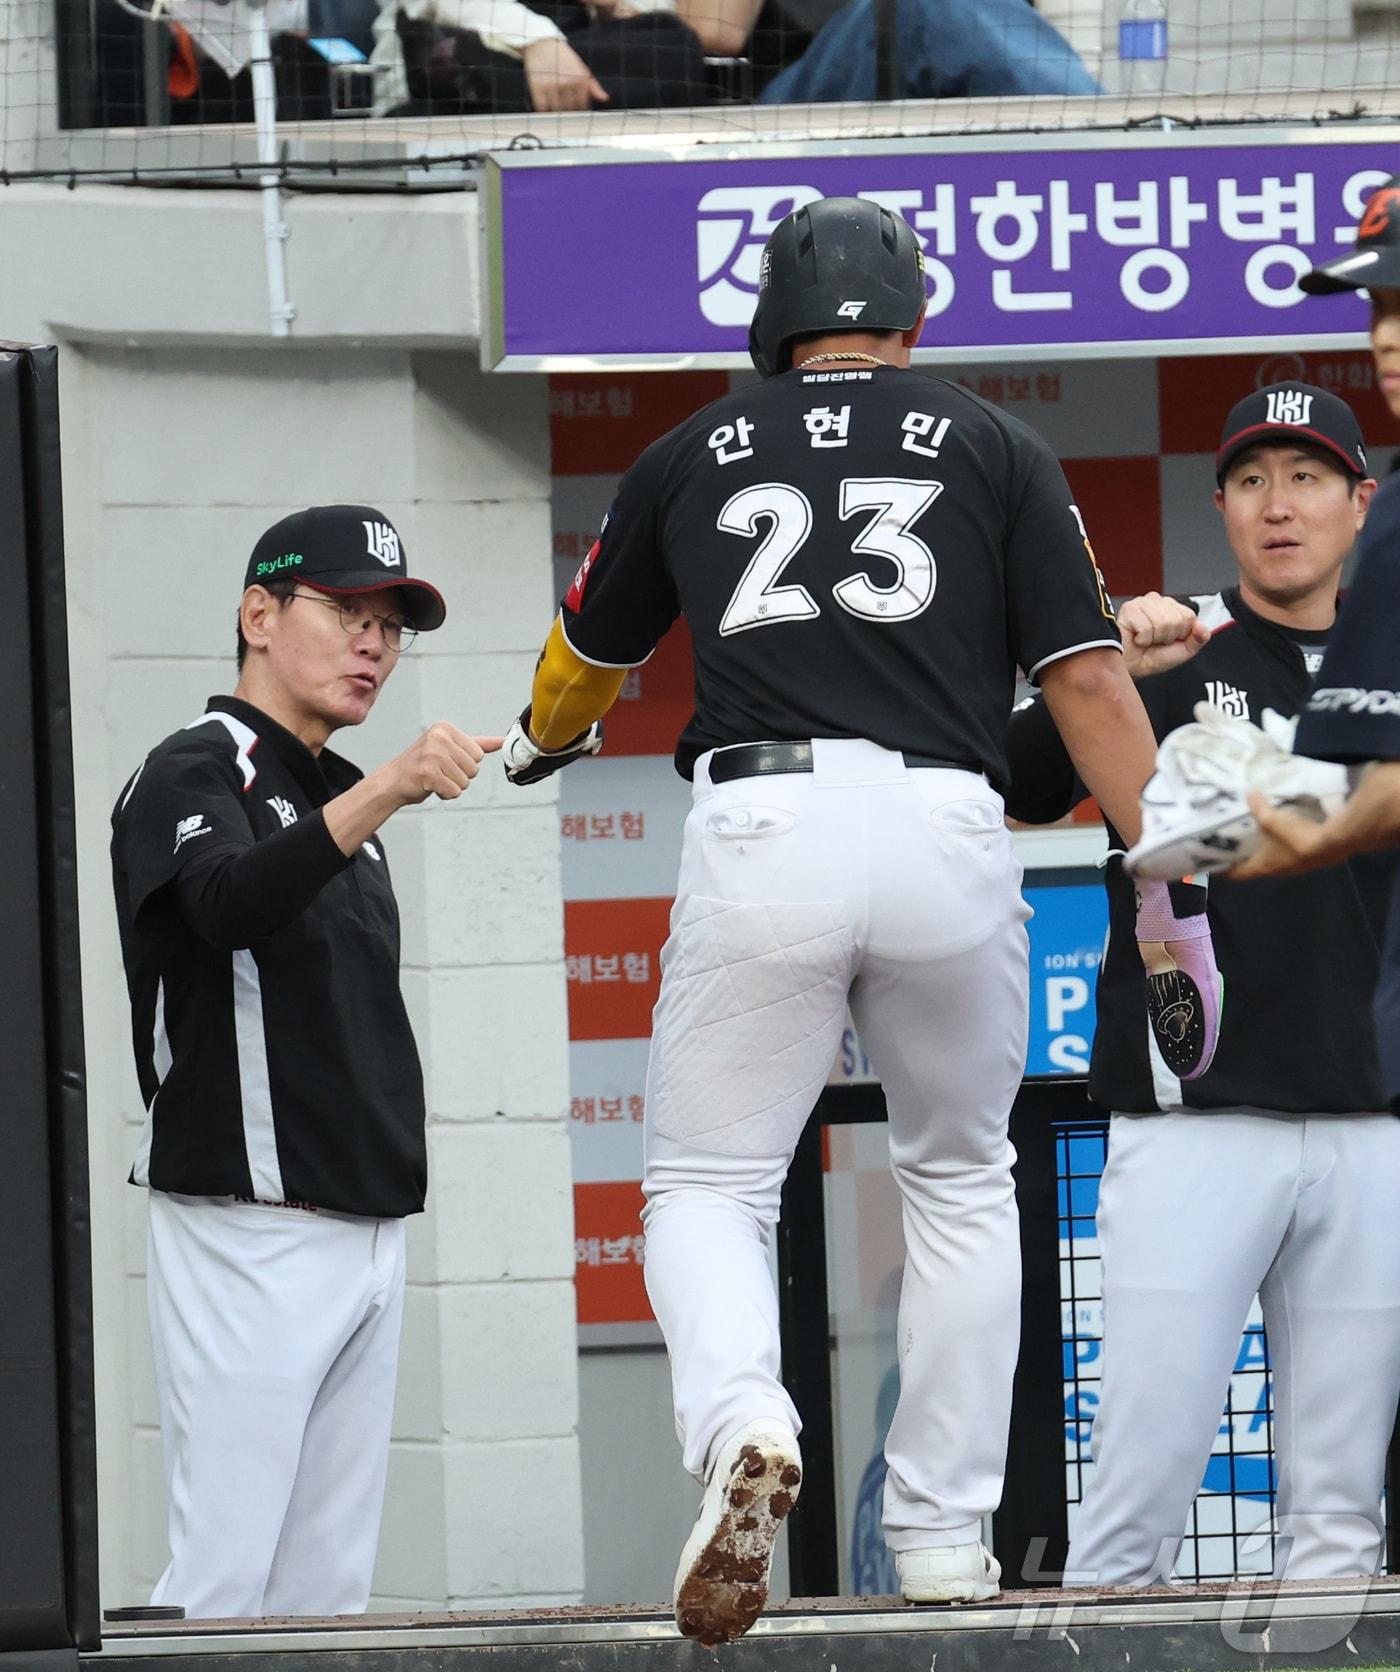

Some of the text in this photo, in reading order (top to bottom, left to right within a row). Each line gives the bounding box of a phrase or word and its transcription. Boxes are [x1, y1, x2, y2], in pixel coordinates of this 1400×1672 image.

[716, 477, 944, 637] 23
[561, 811, 645, 840] 해보험
[565, 952, 650, 984] 해보험
